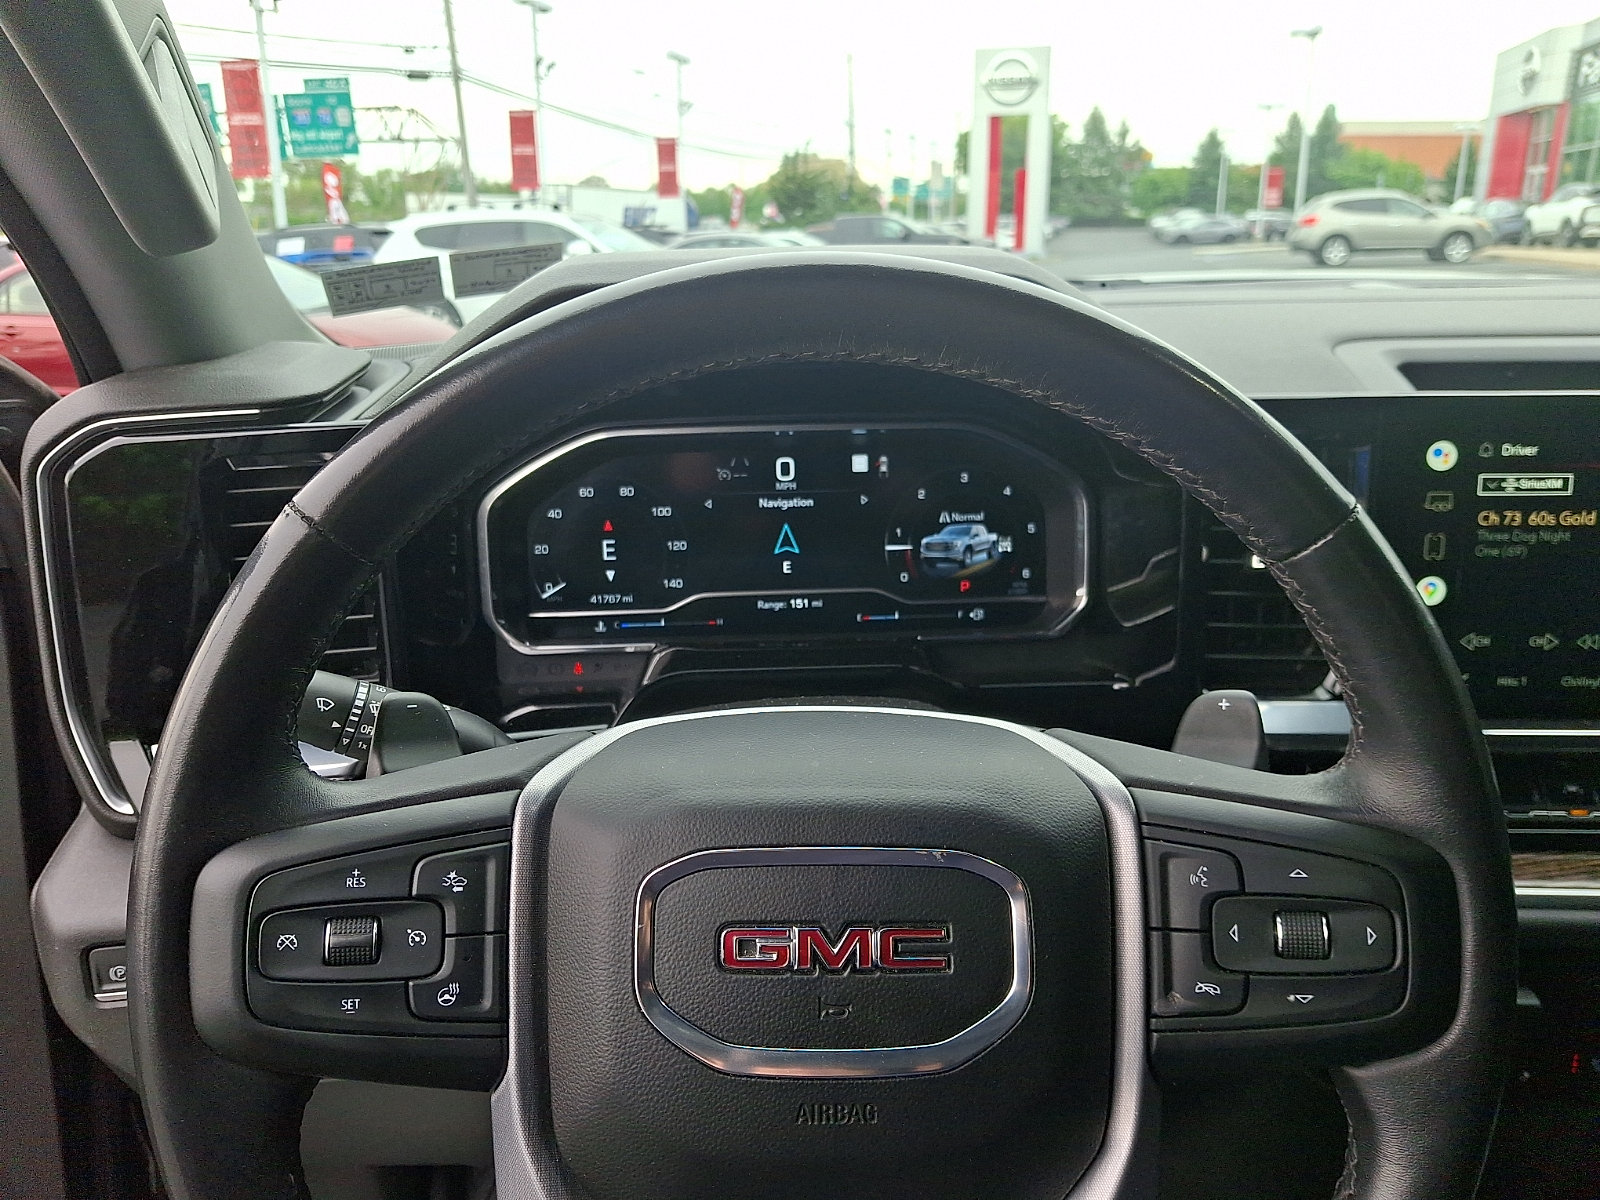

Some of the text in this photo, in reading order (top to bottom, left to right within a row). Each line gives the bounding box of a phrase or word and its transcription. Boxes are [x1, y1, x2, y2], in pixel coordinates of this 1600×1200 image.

[1501, 443, 1540, 456] Driver
[775, 456, 796, 482] 0
[960, 472, 969, 483] 3
[579, 487, 595, 498] 60
[619, 486, 635, 497] 80
[775, 482, 797, 491] MPH
[1002, 485, 1012, 496] 4
[917, 488, 926, 500] 2
[758, 497, 815, 511] Navigation
[547, 508, 563, 519] 40
[652, 507, 672, 518] 100
[951, 511, 985, 523] Normal
[1477, 509, 1598, 526] Ch 73 60s Gold
[895, 527, 902, 538] 1
[1027, 522, 1036, 534] 5
[534, 544, 549, 555] 20
[602, 539, 617, 561] E
[667, 540, 687, 552] 120
[782, 560, 793, 574] E
[1022, 567, 1031, 579] 6
[900, 571, 909, 583] 0
[545, 581, 554, 592] 0
[663, 578, 684, 590] 140
[960, 580, 971, 592] P
[622, 593, 634, 604] mi
[757, 598, 823, 611] Range: 151 mi
[346, 878, 366, 889] RES
[720, 926, 952, 971] GMC
[341, 999, 360, 1011] SET
[796, 1103, 878, 1126] AIRBAG
